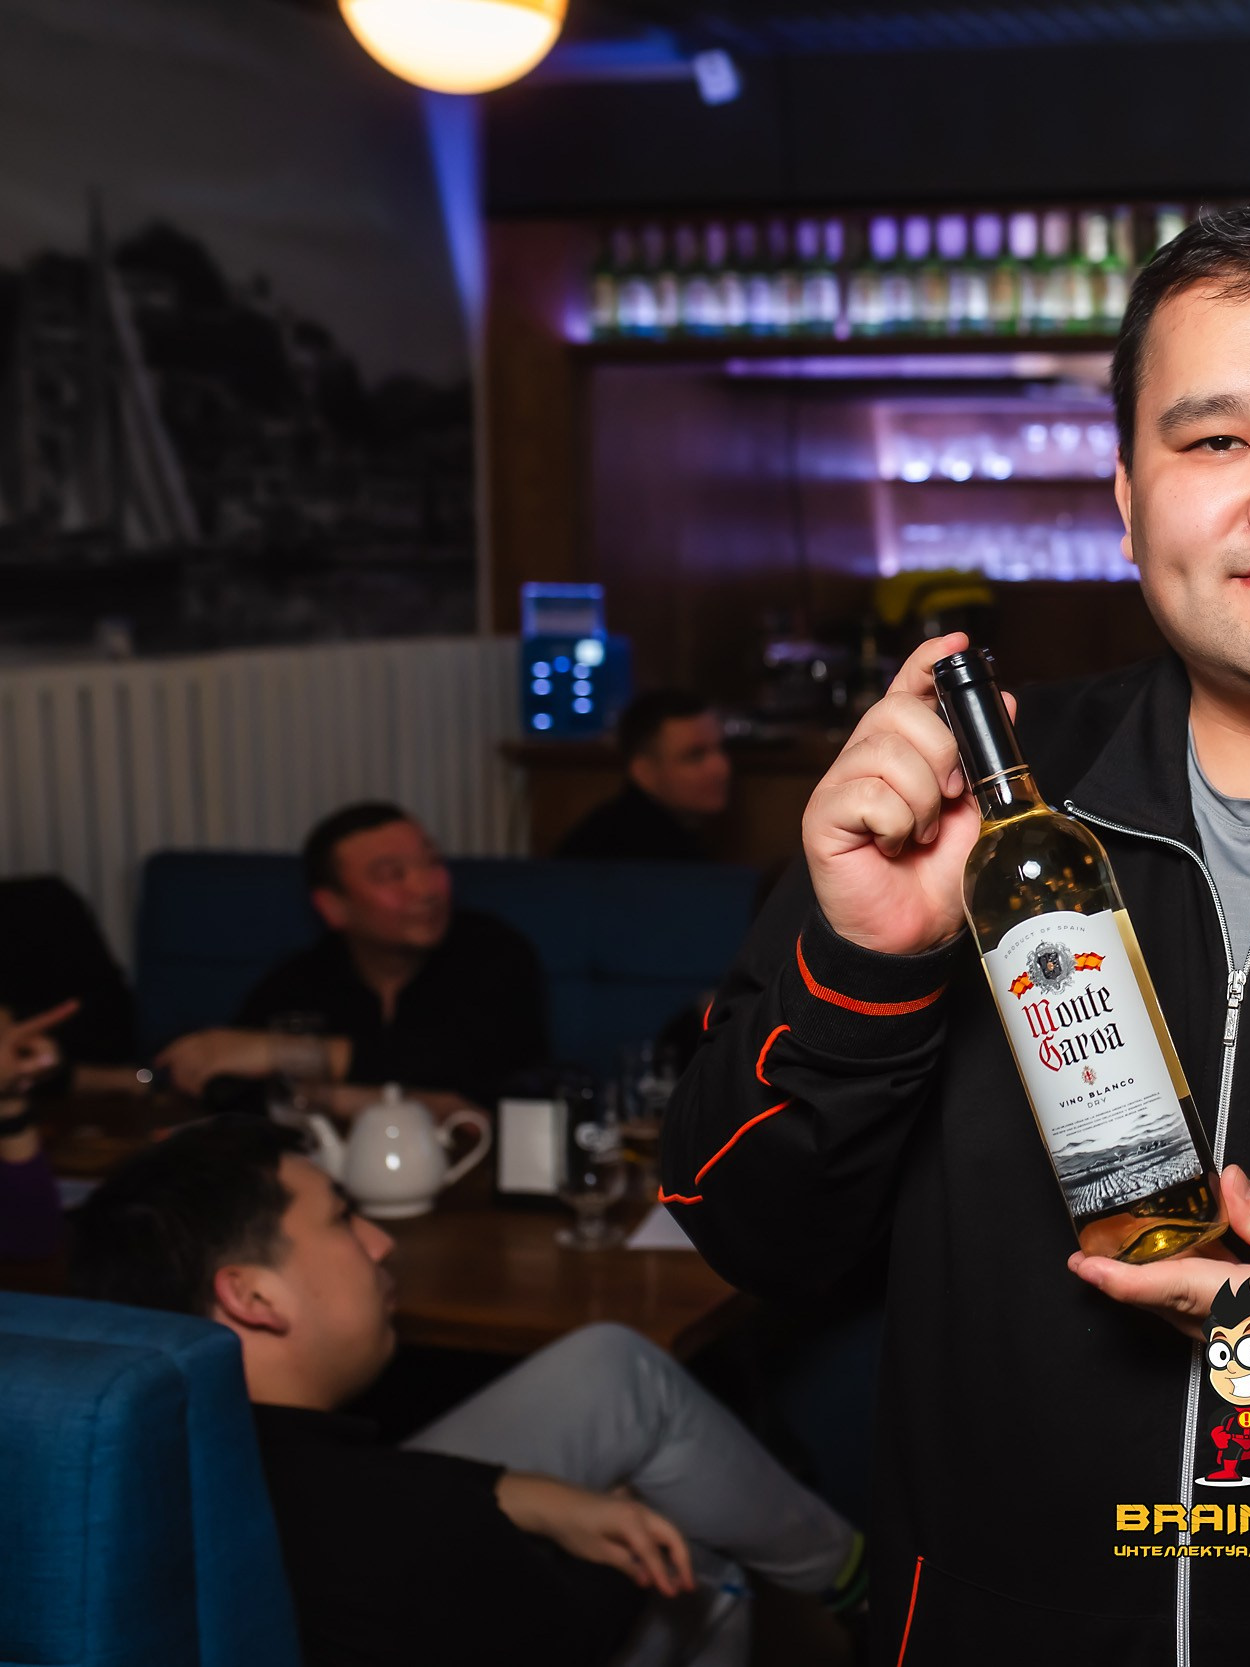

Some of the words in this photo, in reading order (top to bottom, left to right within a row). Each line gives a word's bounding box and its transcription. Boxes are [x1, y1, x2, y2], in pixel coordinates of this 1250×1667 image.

[1004, 932, 1034, 959] PRODUCT
[1022, 983, 1114, 1038] Monte
[1059, 1095, 1084, 1108] VINO
[1088, 1077, 1134, 1099] BLANCO
[1087, 1097, 1107, 1109] DRY
